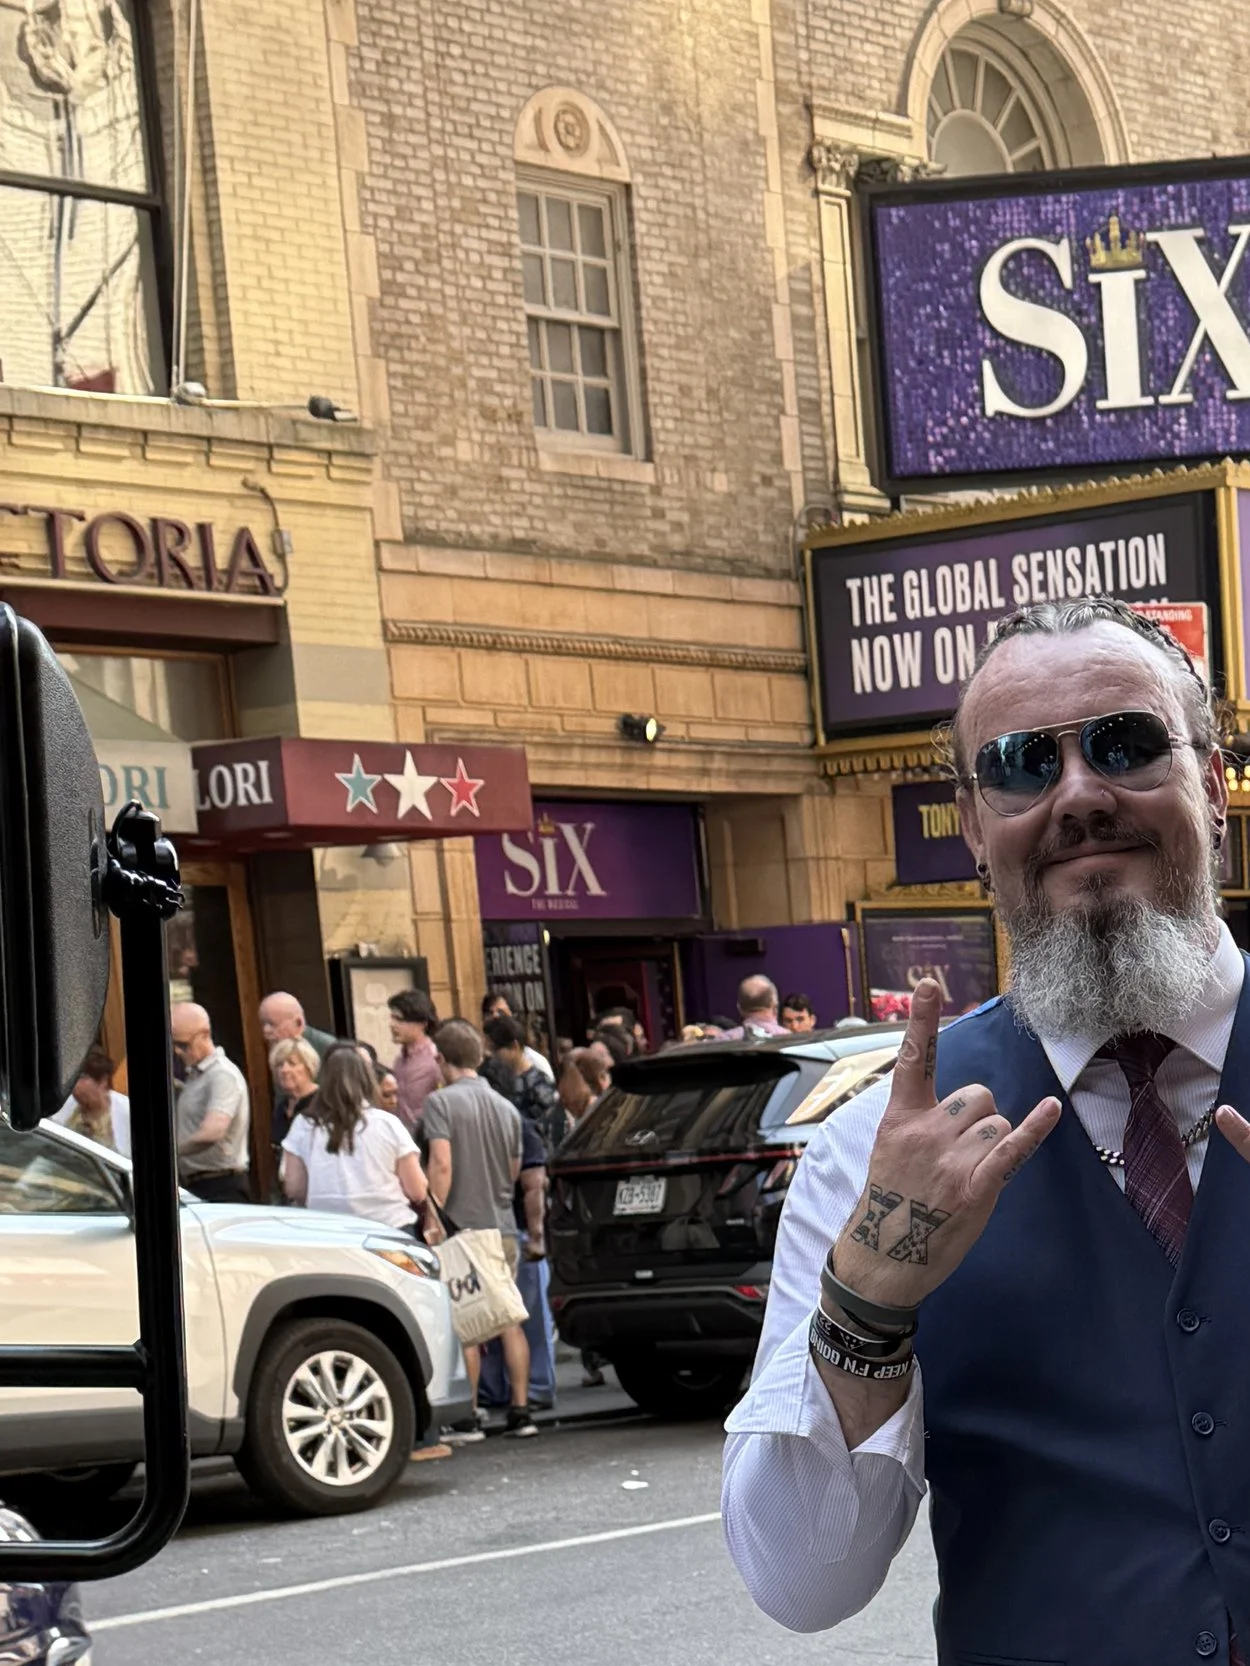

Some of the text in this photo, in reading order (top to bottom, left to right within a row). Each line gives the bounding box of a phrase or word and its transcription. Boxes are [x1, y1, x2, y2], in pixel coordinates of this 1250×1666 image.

[0, 502, 278, 597] TORIA
[846, 533, 1168, 627] THE GLOBAL SENSATION
[851, 624, 976, 695] NOW ON
[873, 1360, 909, 1379] KEEP
